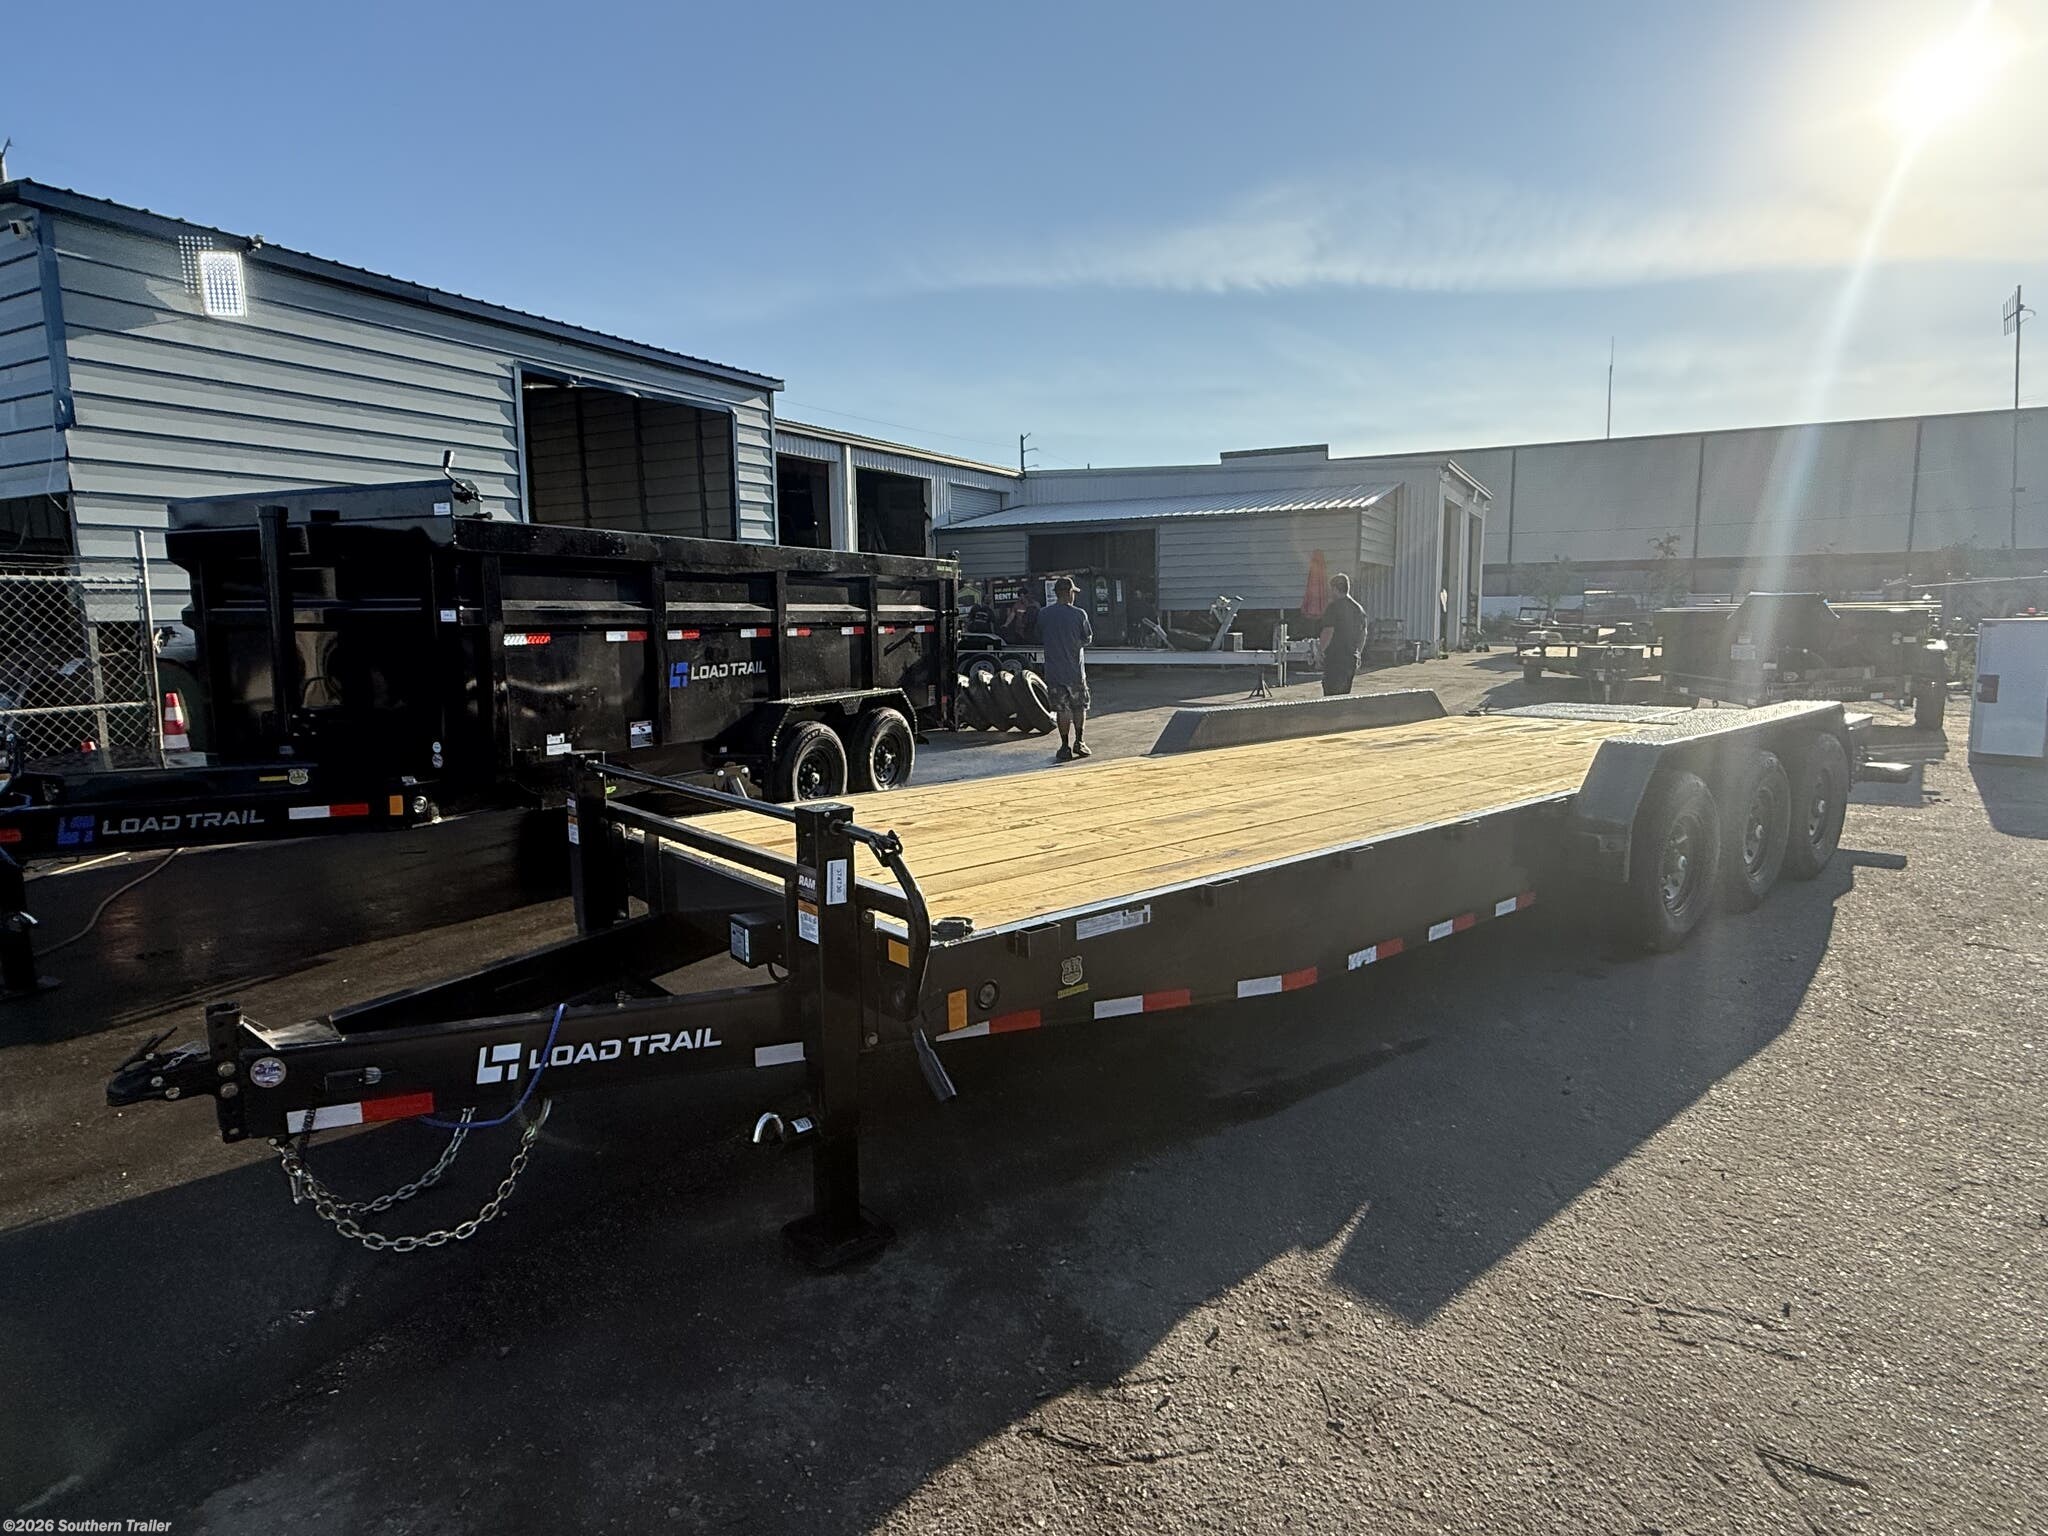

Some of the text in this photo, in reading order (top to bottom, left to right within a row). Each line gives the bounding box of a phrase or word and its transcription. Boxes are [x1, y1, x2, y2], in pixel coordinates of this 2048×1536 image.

[691, 664, 729, 680] LOAD
[730, 661, 766, 676] TRAIL
[102, 815, 180, 835] LOAD
[186, 809, 265, 828] TRAIL
[798, 875, 816, 890] RAM
[528, 1039, 621, 1070] LOAD
[628, 1028, 722, 1056] TRAIL
